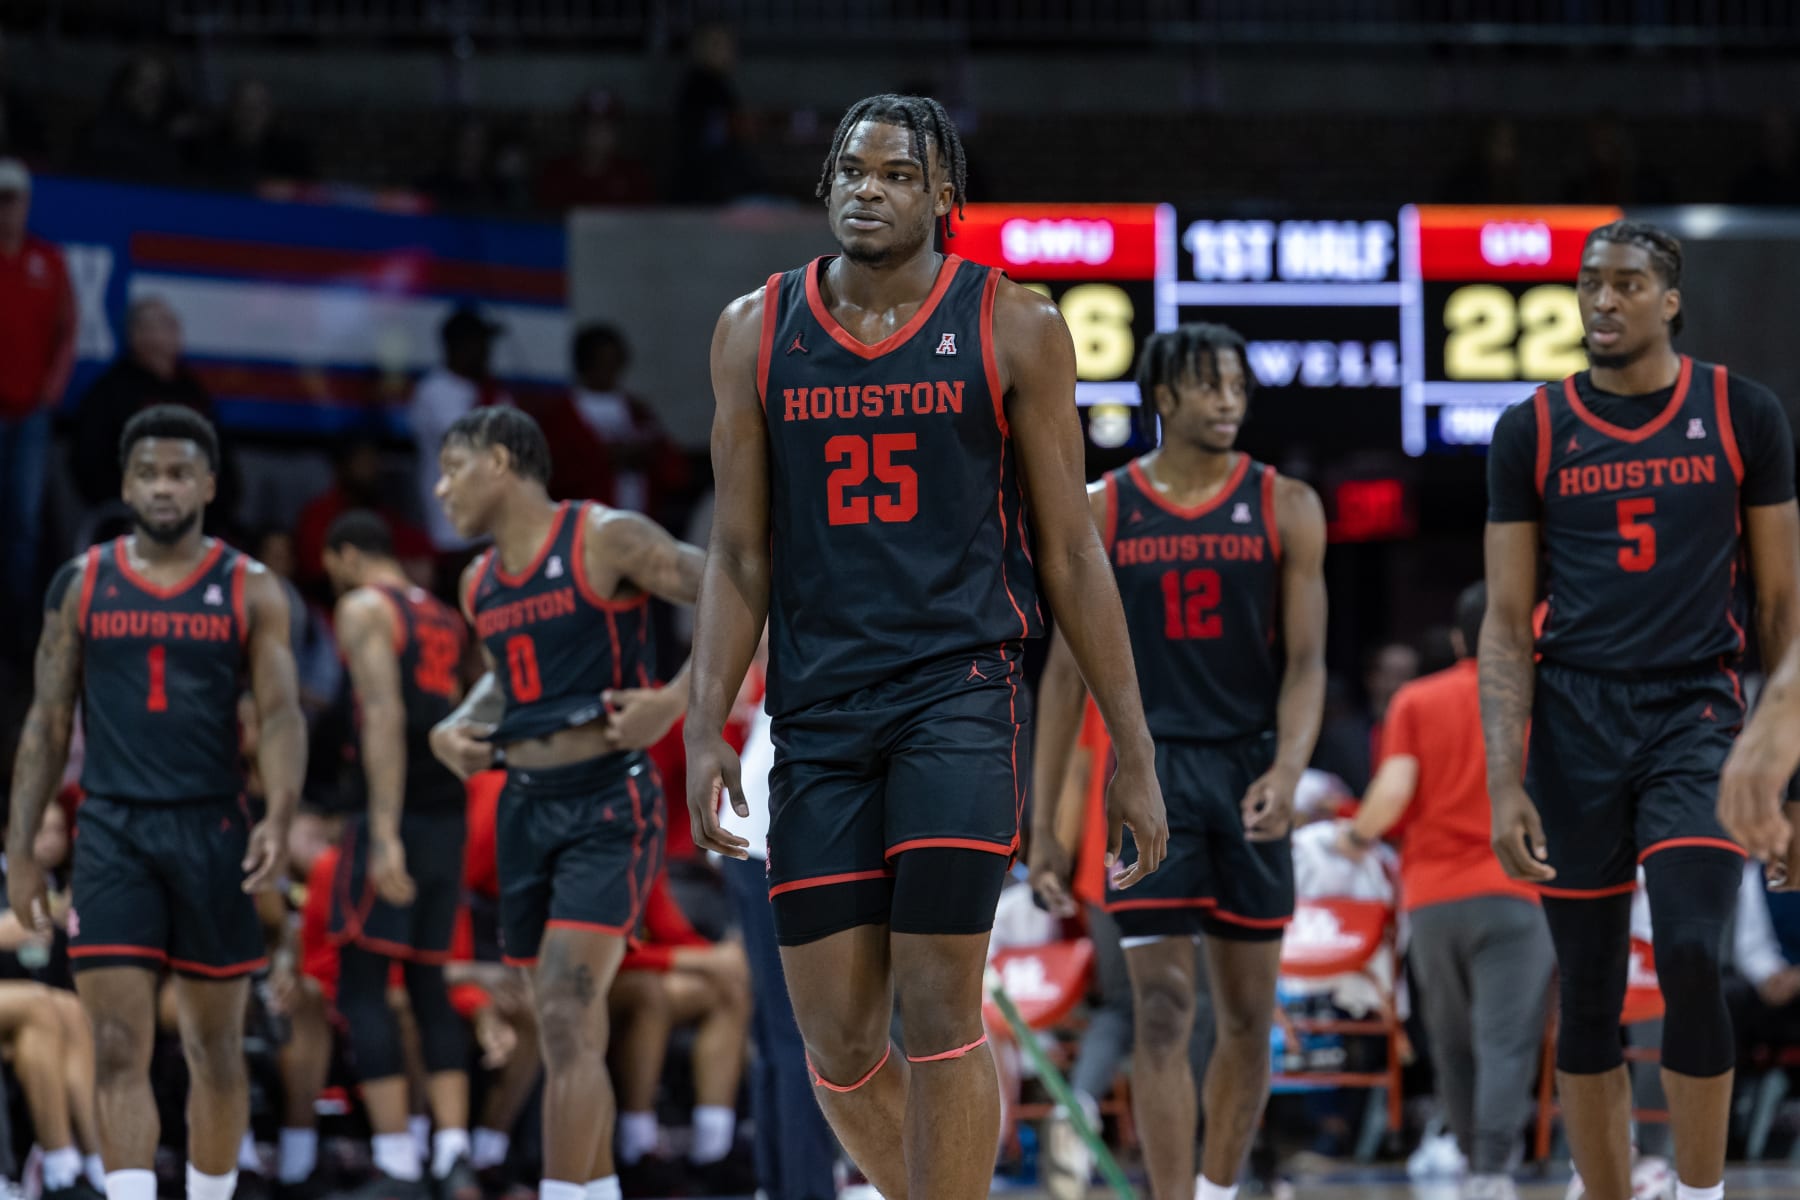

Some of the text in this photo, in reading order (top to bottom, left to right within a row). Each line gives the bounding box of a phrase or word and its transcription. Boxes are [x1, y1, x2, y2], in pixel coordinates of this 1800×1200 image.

[1182, 220, 1394, 280] 1ST HALF
[1025, 283, 1135, 381] 6
[1444, 284, 1590, 381] 22
[783, 380, 965, 422] HOUSTON
[825, 432, 918, 526] 25
[1558, 455, 1716, 496] HOUSTON
[1116, 533, 1265, 567] HOUSTON
[1616, 498, 1656, 573] 5
[91, 610, 232, 642] HOUSTON
[475, 586, 577, 639] HOUSTON
[1161, 568, 1223, 640] 12
[147, 644, 168, 712] 1
[506, 634, 542, 704] 0
